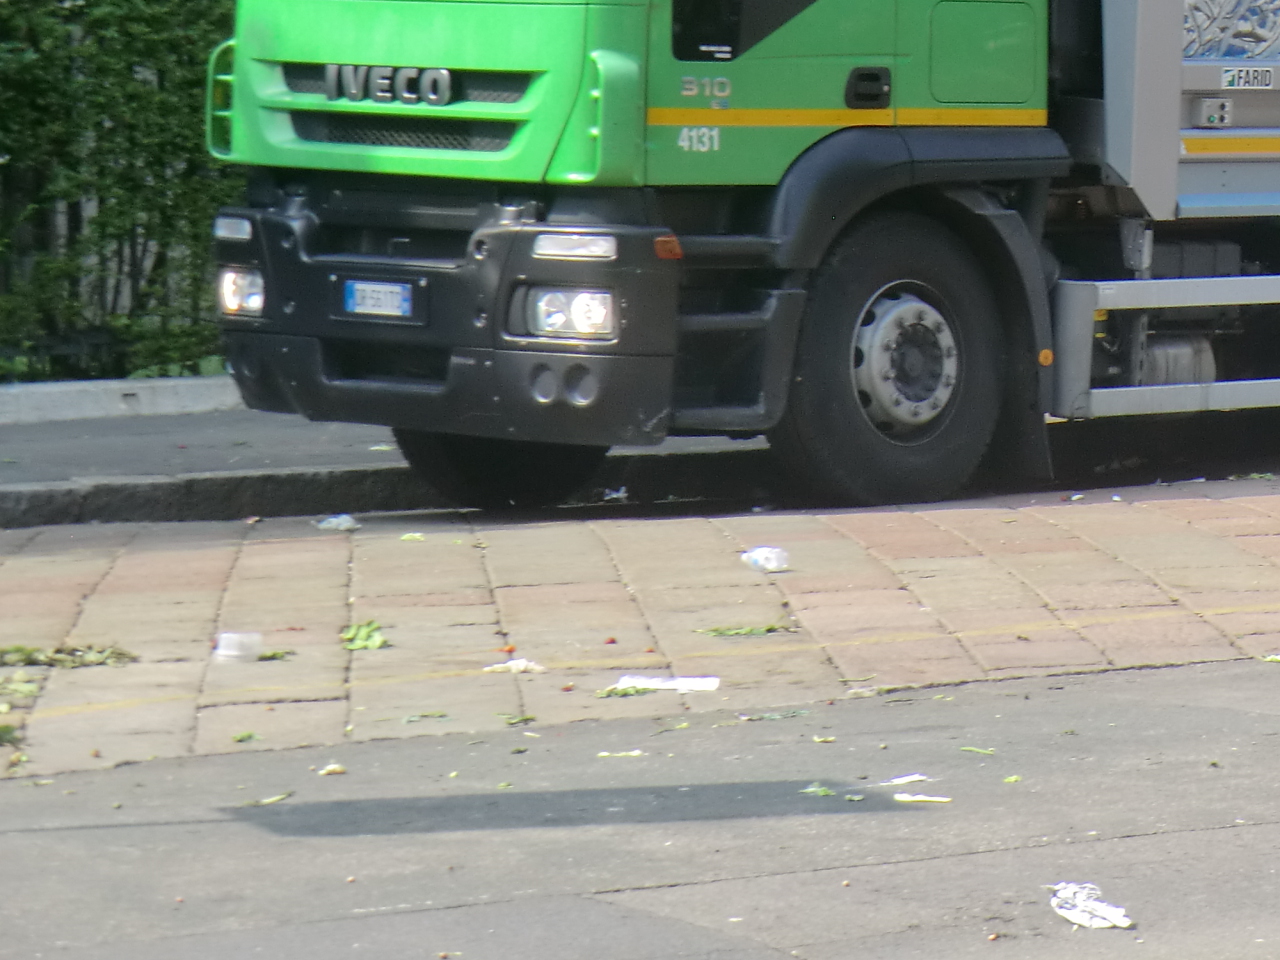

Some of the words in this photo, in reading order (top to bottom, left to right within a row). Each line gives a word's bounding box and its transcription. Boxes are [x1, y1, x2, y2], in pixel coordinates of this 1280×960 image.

[325, 63, 452, 107] IVECO
[681, 76, 731, 97] 310
[1237, 69, 1272, 87] FARID
[678, 126, 720, 152] 4131
